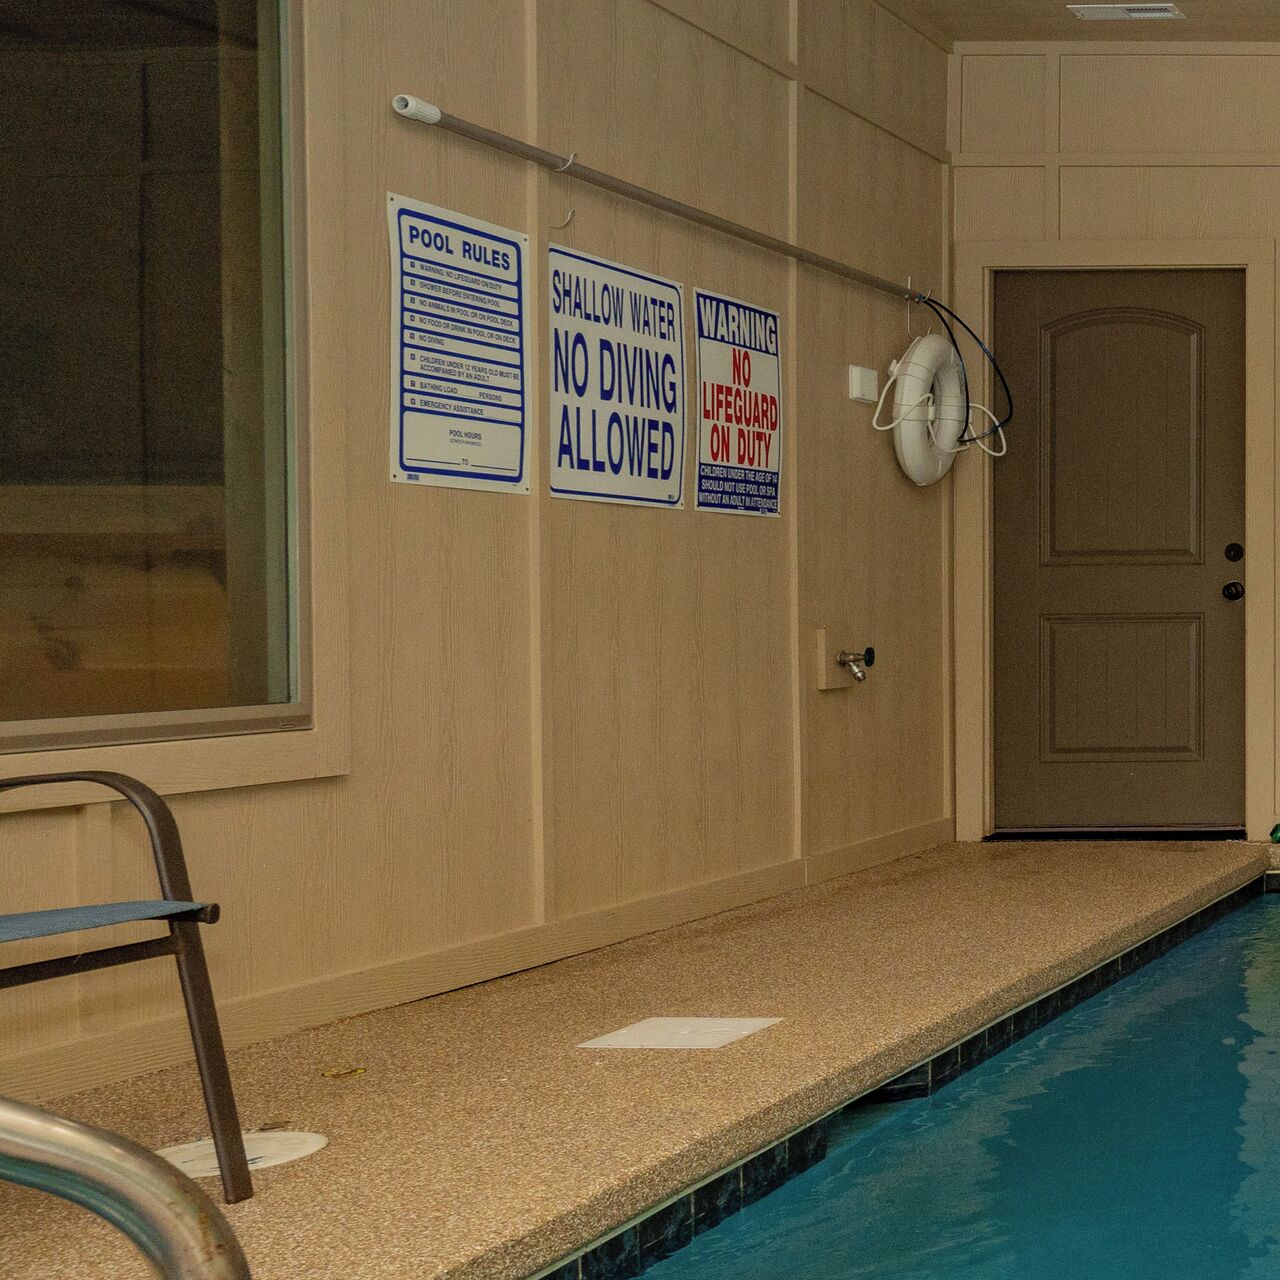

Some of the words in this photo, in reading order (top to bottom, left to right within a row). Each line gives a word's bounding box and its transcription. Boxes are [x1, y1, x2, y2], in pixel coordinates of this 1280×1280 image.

[409, 225, 453, 254] POOL
[462, 240, 510, 270] RULES
[446, 270, 453, 278] NO
[454, 272, 480, 286] LIFEGUARD
[489, 282, 502, 291] DUTY
[420, 281, 441, 291] SHOWER
[443, 287, 461, 297] BEFORE
[463, 292, 486, 304] ENTERING
[488, 298, 500, 307] POOL
[552, 270, 624, 328] SHALLOW
[630, 291, 675, 342] WATER
[428, 302, 449, 312] ANIMALS
[457, 308, 469, 317] POOL
[487, 315, 500, 324] POOL
[500, 319, 513, 327] DECK
[699, 297, 776, 354] WARNING
[427, 336, 444, 345] DIVING
[428, 319, 442, 328] FOOD
[451, 324, 465, 333] DRINK
[473, 329, 486, 337] POOL
[503, 336, 515, 344] DECK
[420, 356, 445, 366] CHILDREN
[446, 360, 464, 369] UNDER
[471, 366, 487, 374] YEARS
[499, 371, 512, 379] MUST
[420, 364, 457, 376] ACCOMPANIED
[474, 374, 490, 382] ADULT
[554, 328, 589, 397] NO
[600, 339, 676, 414] DIVING
[732, 348, 751, 388] NO
[420, 382, 442, 392] BATHING
[444, 386, 457, 394] LOAD
[479, 392, 502, 402] PERSONS
[420, 400, 451, 410] EMERGENCY
[453, 405, 484, 415] ASSISTANCE
[703, 382, 778, 431] LIFEGUARD
[449, 430, 463, 438] POOL
[464, 432, 481, 440] HOURS
[558, 405, 675, 480] ALLOWED
[710, 424, 730, 462] ON
[737, 428, 772, 468] DUTY
[700, 465, 727, 478] CHILDREN
[728, 468, 745, 480] UNDER
[746, 470, 755, 481] THE
[755, 472, 765, 482] AGE
[765, 473, 771, 483] OF
[772, 474, 777, 484] 14
[702, 479, 723, 491] SHOULD
[724, 481, 735, 492] NOT
[736, 482, 745, 493] USE
[746, 484, 759, 495] POOL
[759, 485, 766, 496] OR
[767, 486, 775, 496] SPA
[699, 492, 721, 504] WITHOUT
[722, 494, 729, 504] AN
[730, 495, 745, 506] ADULT
[745, 496, 750, 506] IN
[751, 497, 777, 509] ATTENDANCE
